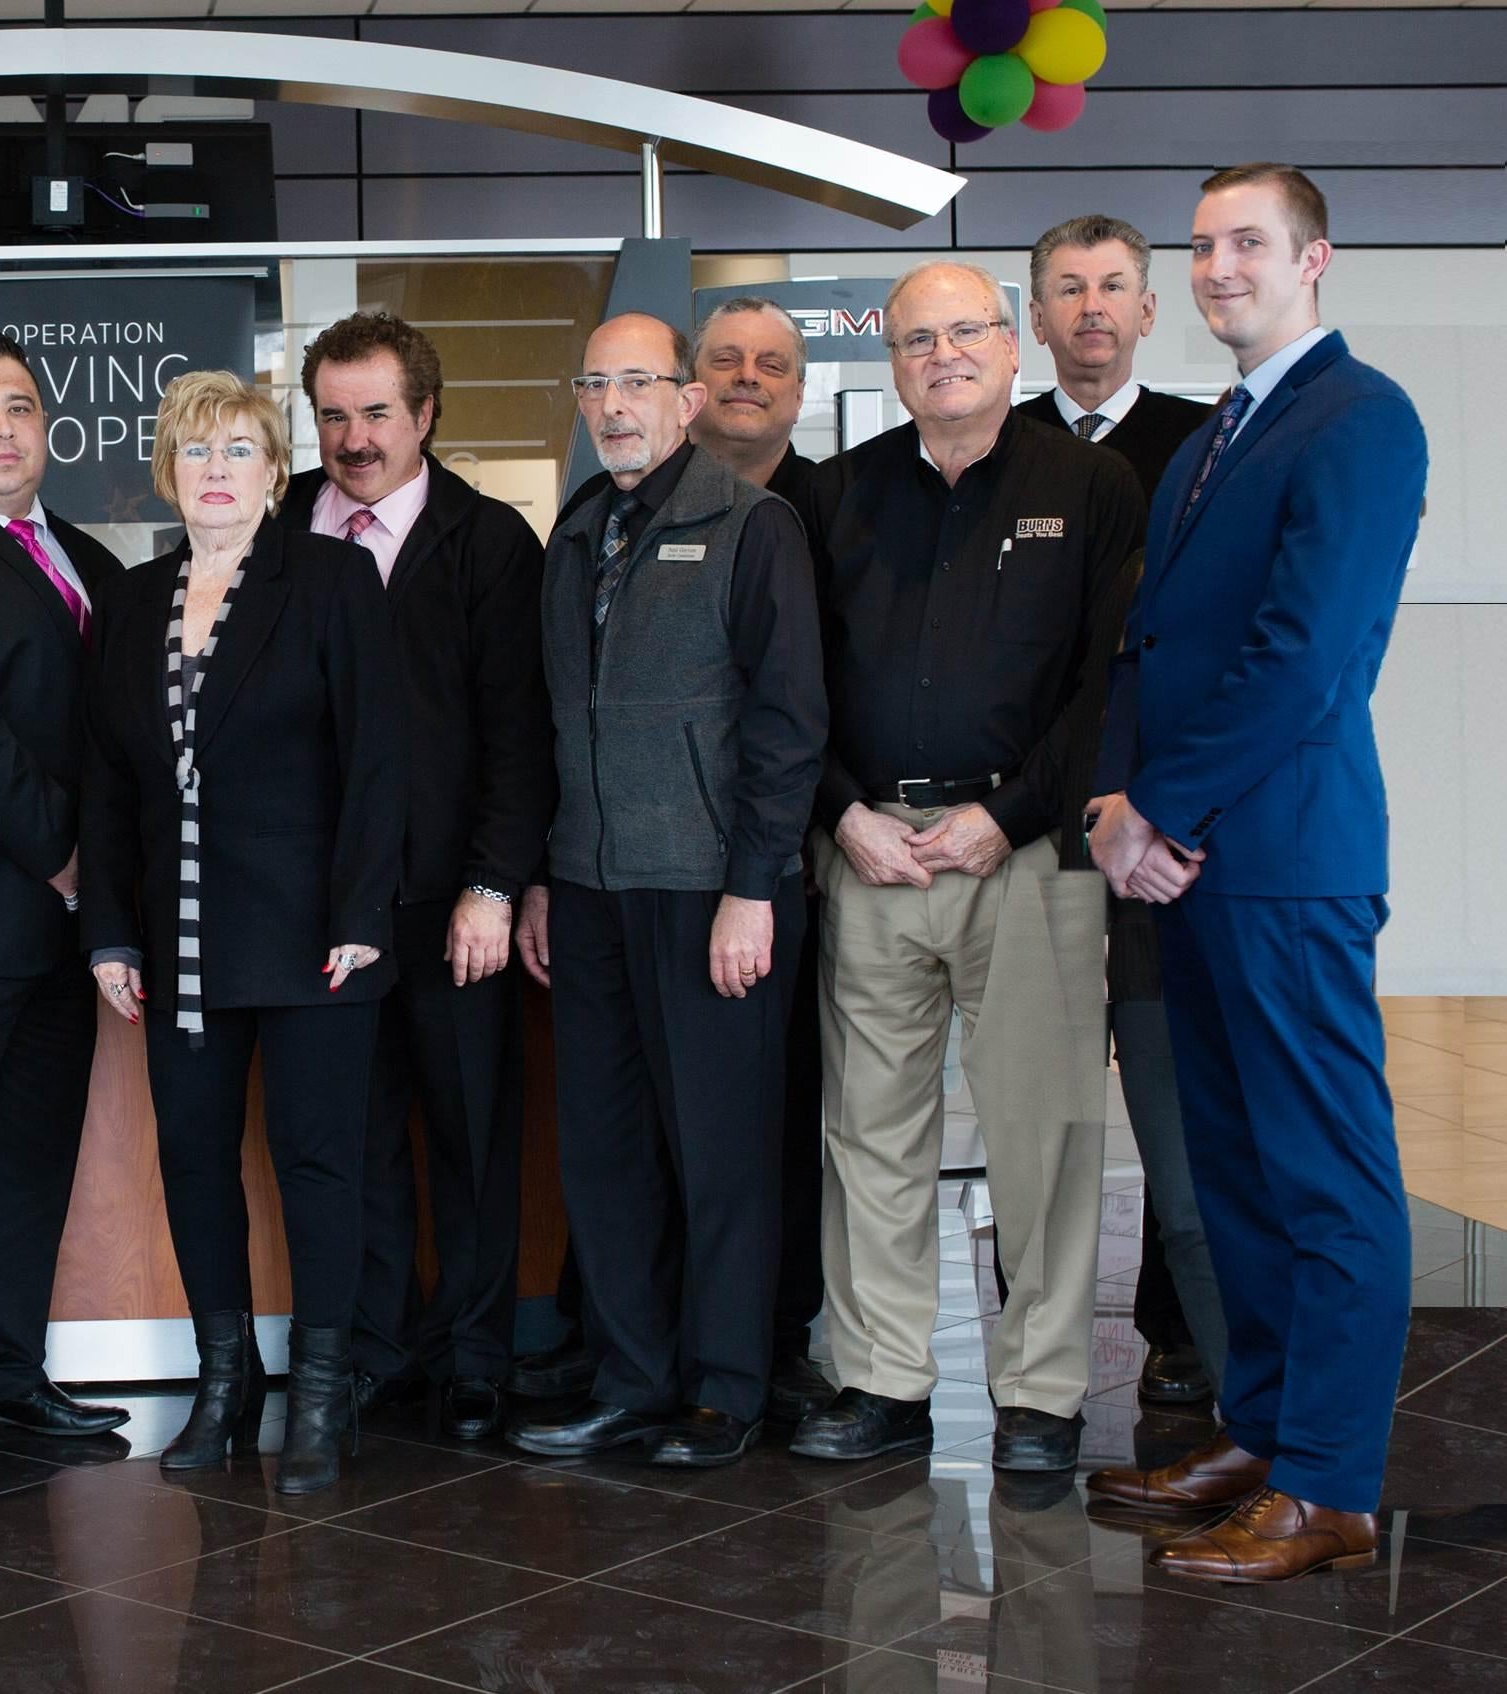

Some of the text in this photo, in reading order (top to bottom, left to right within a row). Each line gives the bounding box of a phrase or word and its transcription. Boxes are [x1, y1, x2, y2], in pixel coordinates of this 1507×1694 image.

[2, 322, 164, 346] OPERATION
[787, 309, 883, 337] GM
[26, 353, 189, 404] VING
[48, 416, 158, 463] OPE
[1017, 518, 1064, 533] BURNS
